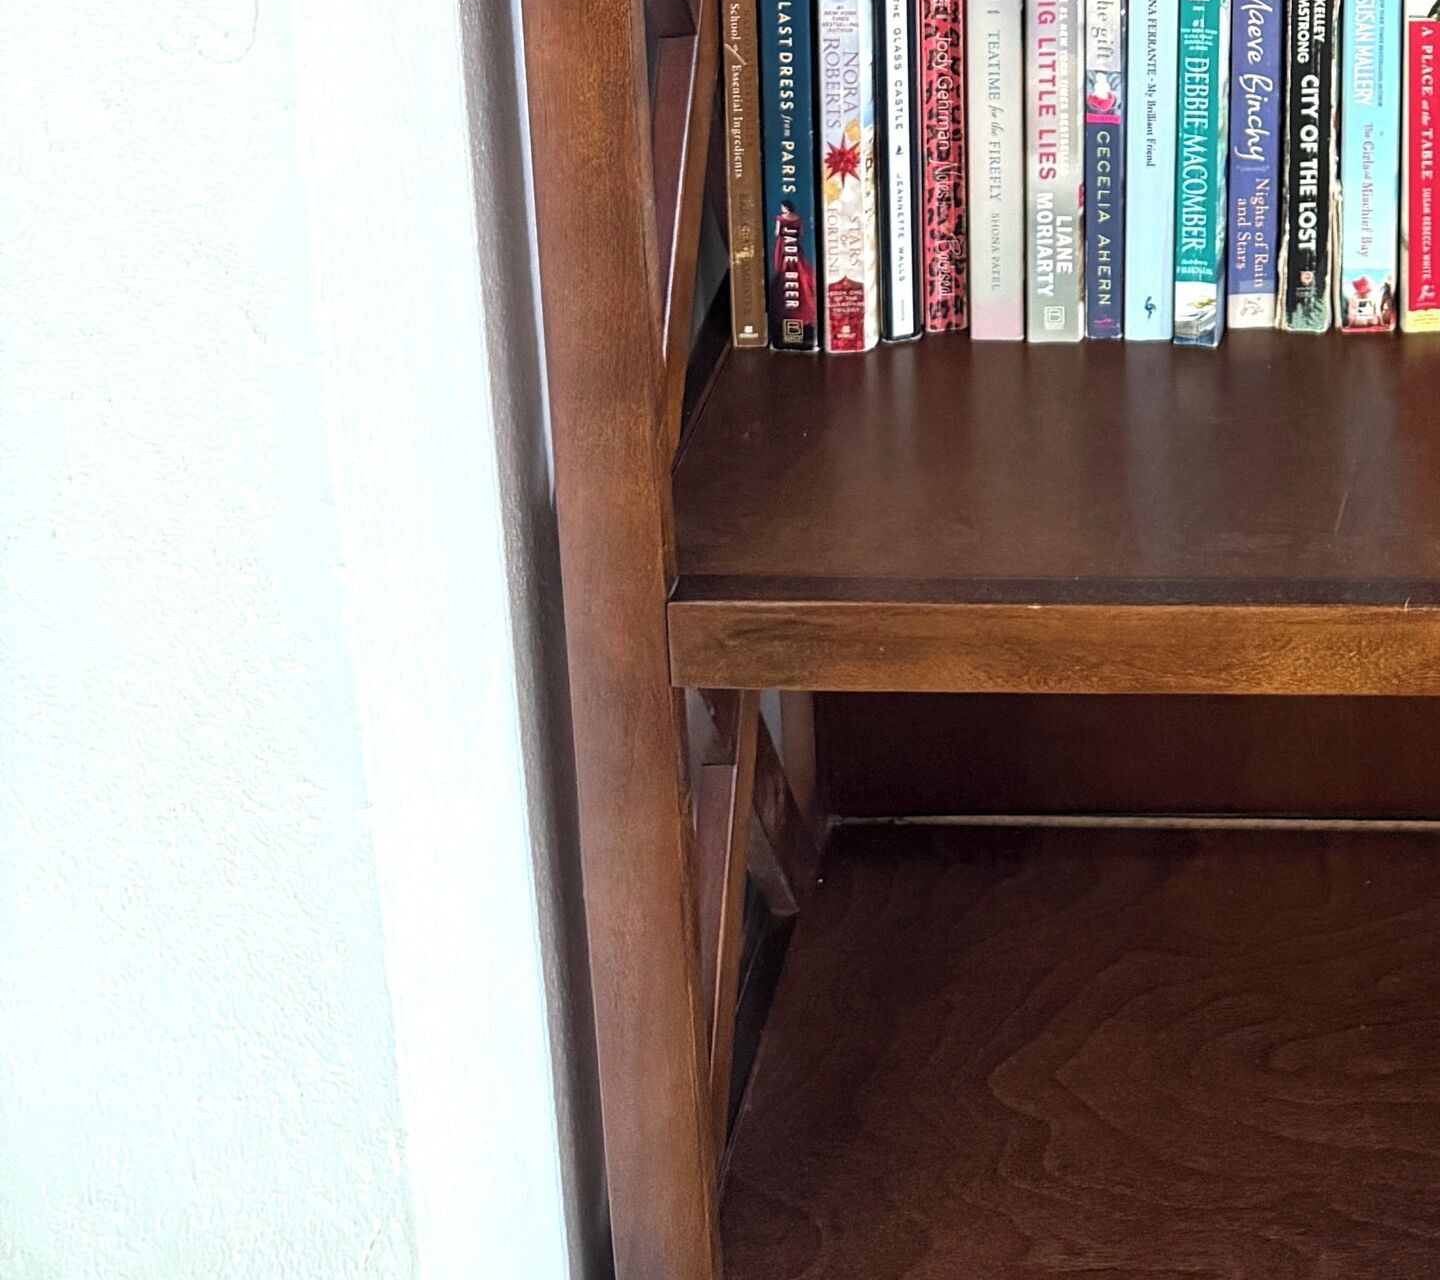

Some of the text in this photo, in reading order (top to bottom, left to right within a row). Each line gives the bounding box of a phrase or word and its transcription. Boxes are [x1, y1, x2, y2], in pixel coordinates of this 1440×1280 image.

[777, 2, 794, 110] LAST DRESS
[1038, 39, 1057, 117] LITTLE
[1184, 57, 1209, 130] DEBBIE
[1038, 131, 1057, 181] LIES
[1234, 74, 1272, 161] Binchy
[782, 141, 796, 193] PARIS
[1181, 133, 1208, 251] MACOMBER
[1298, 74, 1319, 251] CITY OF THE LOST
[1036, 192, 1054, 296] MORIARTY
[1056, 216, 1073, 275] LIANE
[1097, 131, 1112, 305] CECELIA AHERN
